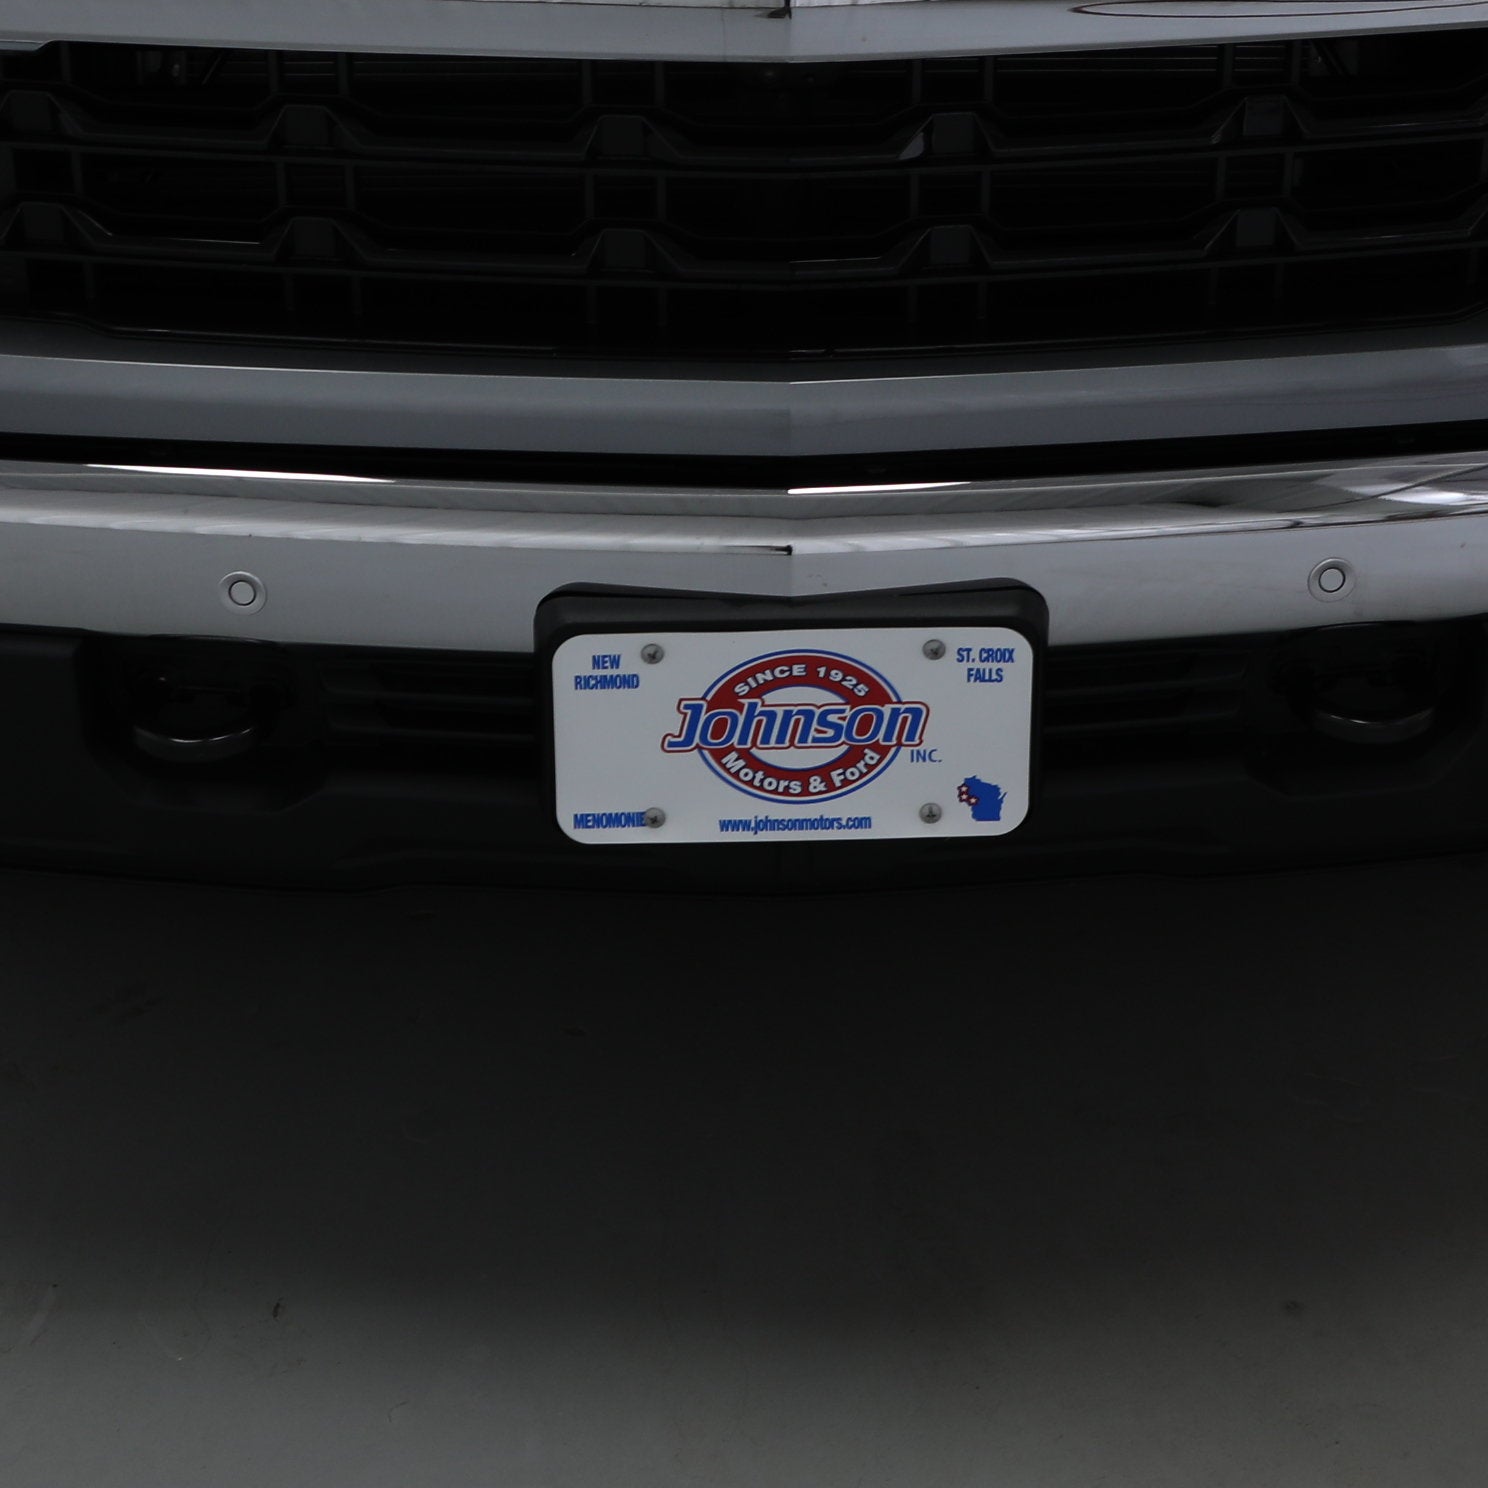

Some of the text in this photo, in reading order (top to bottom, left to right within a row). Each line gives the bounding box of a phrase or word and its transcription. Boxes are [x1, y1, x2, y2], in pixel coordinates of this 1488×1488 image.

[592, 654, 622, 670] NEW
[956, 647, 1015, 663] ST. CROIX
[574, 673, 640, 690] RICHMOND
[733, 664, 870, 698] SINCE 1925
[966, 667, 1004, 683] FALLS
[663, 698, 927, 751] Johnson
[910, 748, 943, 763] INC.
[721, 748, 881, 794] Motors & Ford
[573, 811, 647, 830] MENOMONIE
[718, 815, 872, 835] www.johnsonmotors.com
